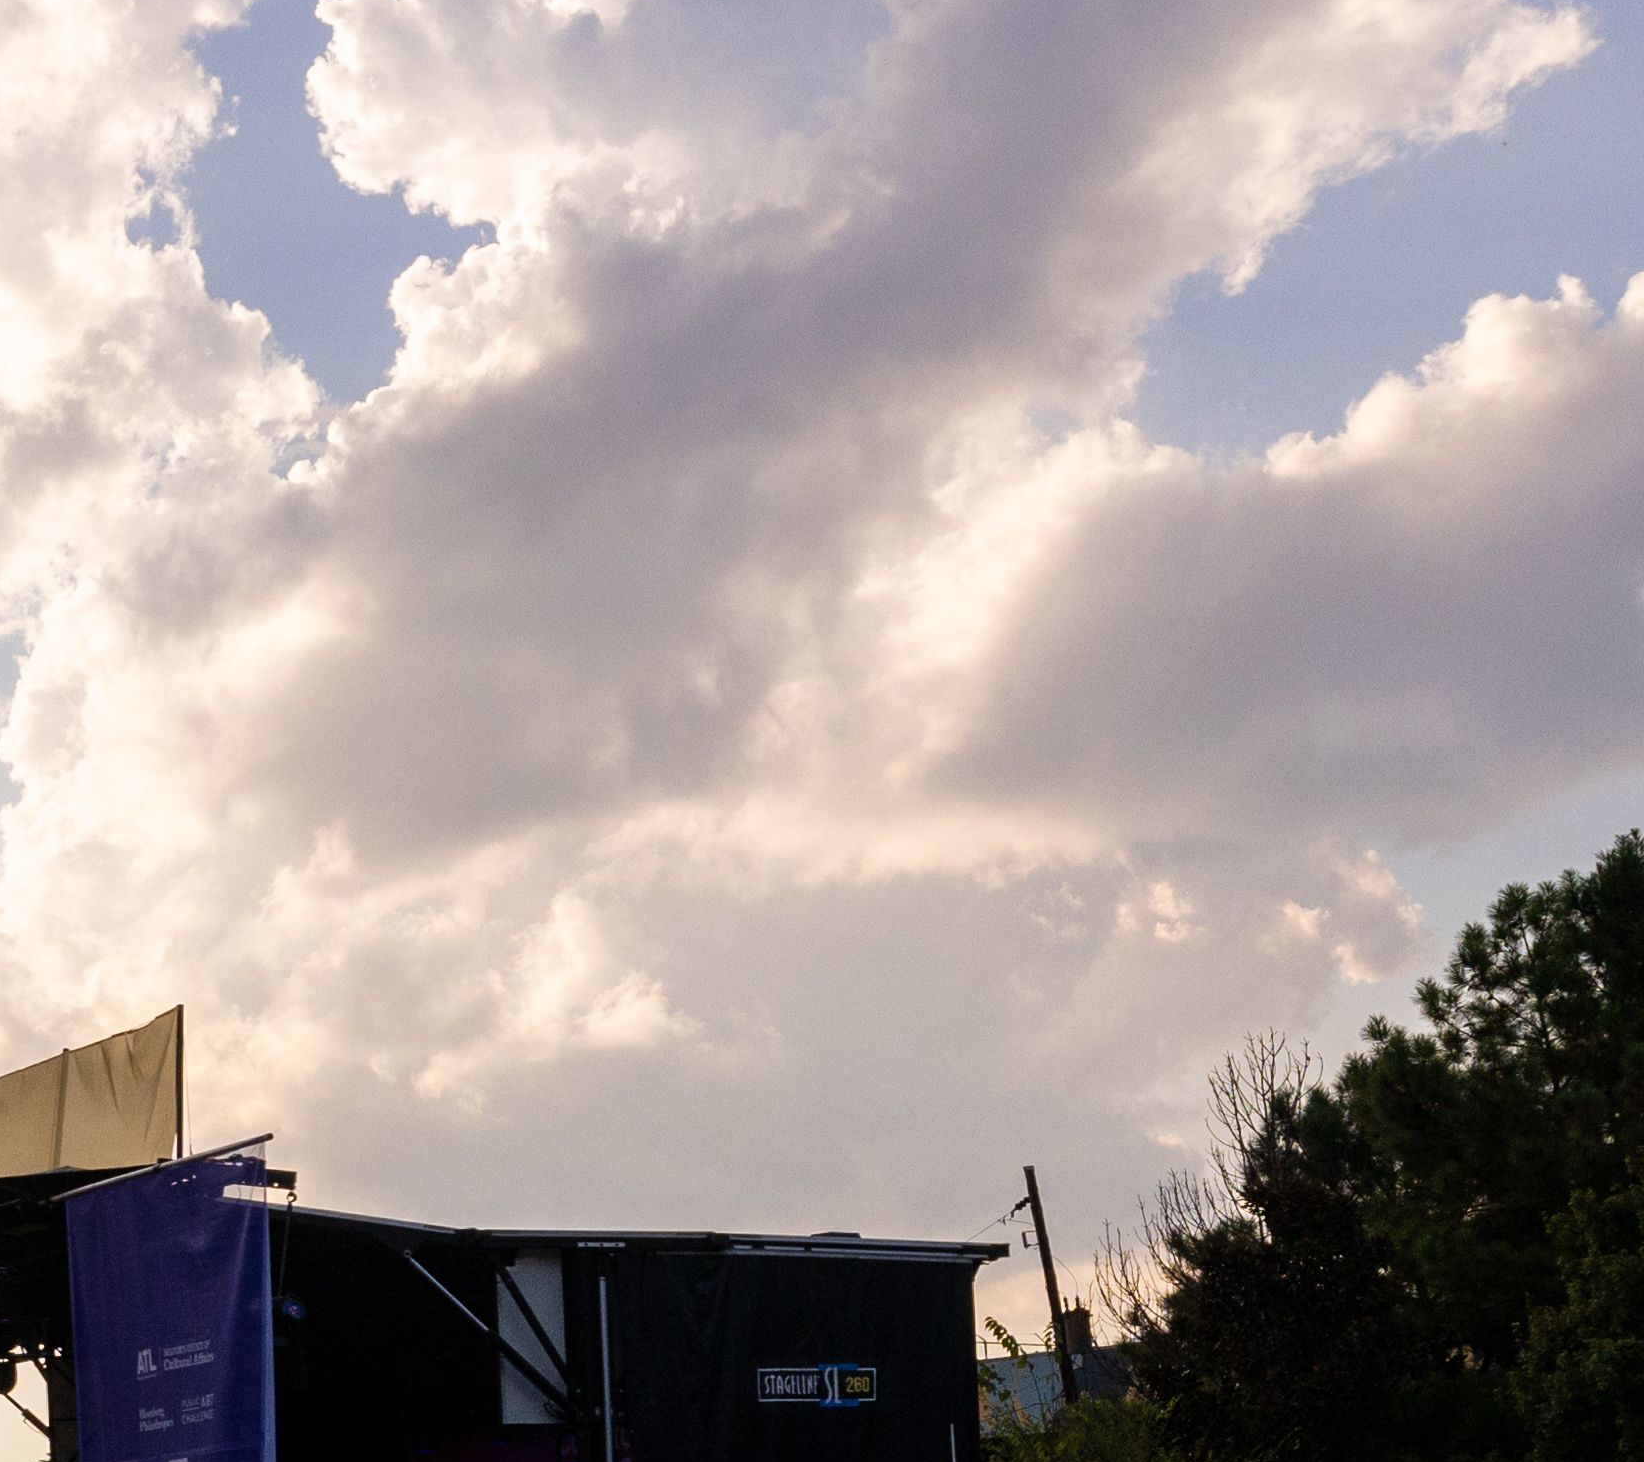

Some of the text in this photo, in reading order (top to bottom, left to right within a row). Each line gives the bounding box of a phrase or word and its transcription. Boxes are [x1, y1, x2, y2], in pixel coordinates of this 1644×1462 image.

[137, 1348, 157, 1375] ATL
[764, 1374, 820, 1395] STAGELINE
[845, 1376, 870, 1393] 260
